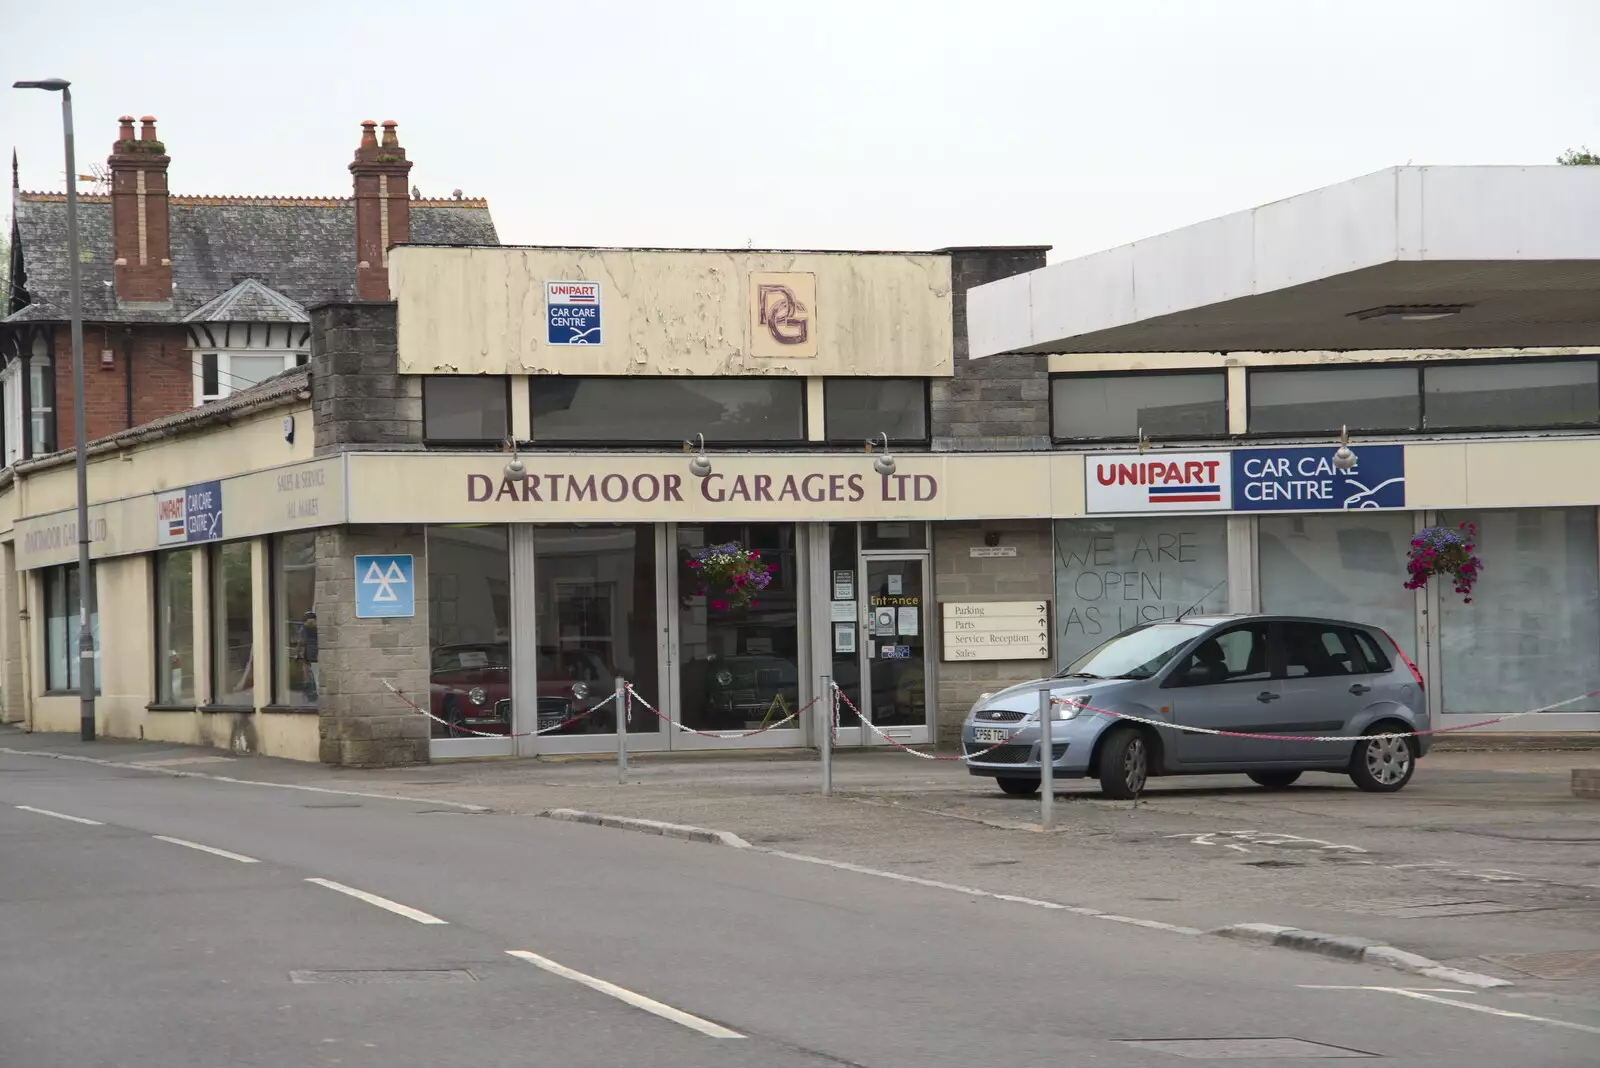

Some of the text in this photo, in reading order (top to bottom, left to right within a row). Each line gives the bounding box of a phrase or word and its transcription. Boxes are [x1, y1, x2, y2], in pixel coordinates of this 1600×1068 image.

[551, 286, 595, 295] UNIPART
[550, 308, 596, 317] CAR CARE
[551, 318, 586, 327] CENTRE
[1096, 460, 1221, 486] UNIPART
[1243, 458, 1293, 478] CAR
[467, 473, 938, 502] DARTMOOR GARAGES LTD
[1244, 480, 1334, 501] CENTRE
[159, 497, 184, 520] UNIPART
[187, 491, 212, 512] CAR CARE
[188, 513, 208, 533] CENTRE
[1055, 532, 1197, 568] WE ARE
[1075, 571, 1162, 601] OPEN
[954, 606, 985, 616] Parking
[955, 620, 976, 629] Parts
[1064, 606, 1102, 637] AS
[955, 634, 1029, 645] Service Reception
[955, 649, 976, 658] Sales
